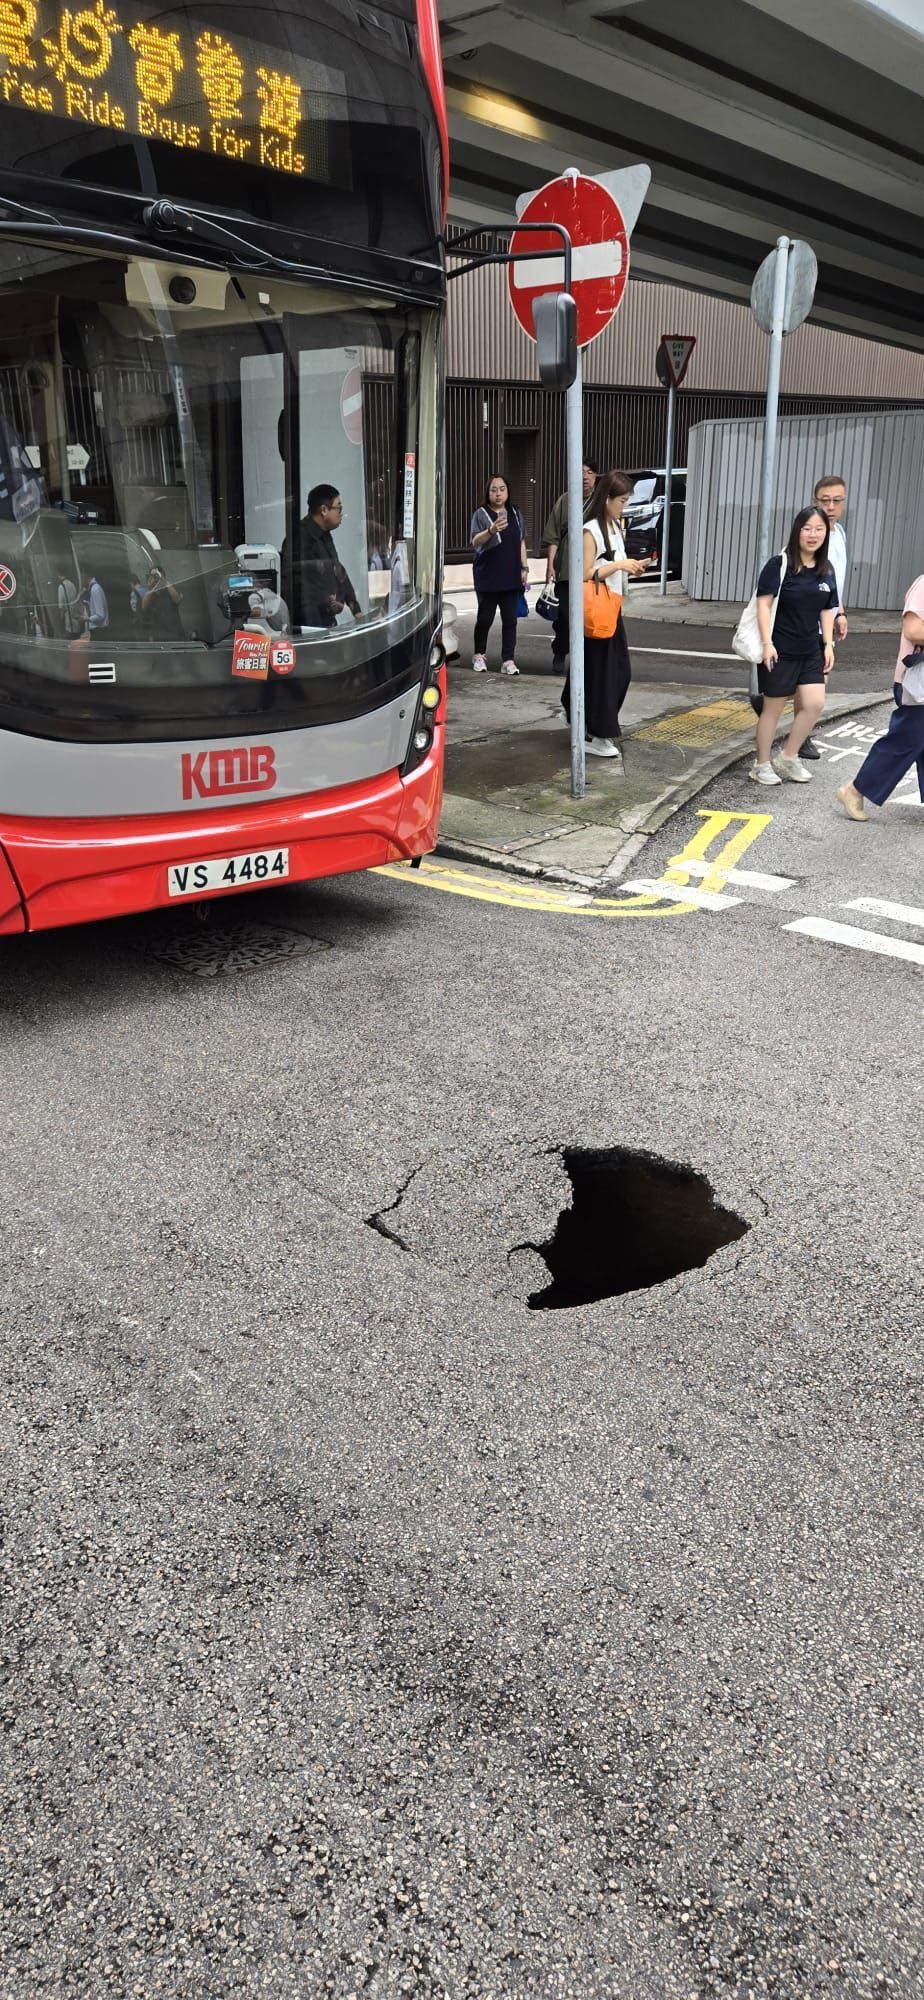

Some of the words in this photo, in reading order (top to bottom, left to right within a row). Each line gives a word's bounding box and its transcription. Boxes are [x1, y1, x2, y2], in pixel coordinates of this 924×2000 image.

[0, 69, 53, 112] ree
[65, 80, 125, 130] Ride
[137, 99, 201, 149] Days
[259, 132, 305, 174] Kids
[235, 637, 269, 653] Tourist
[277, 651, 290, 664] 5G
[236, 657, 268, 670] 旅客日票
[181, 745, 277, 800] KMB
[173, 864, 208, 892] VS
[222, 851, 284, 883] 4484
